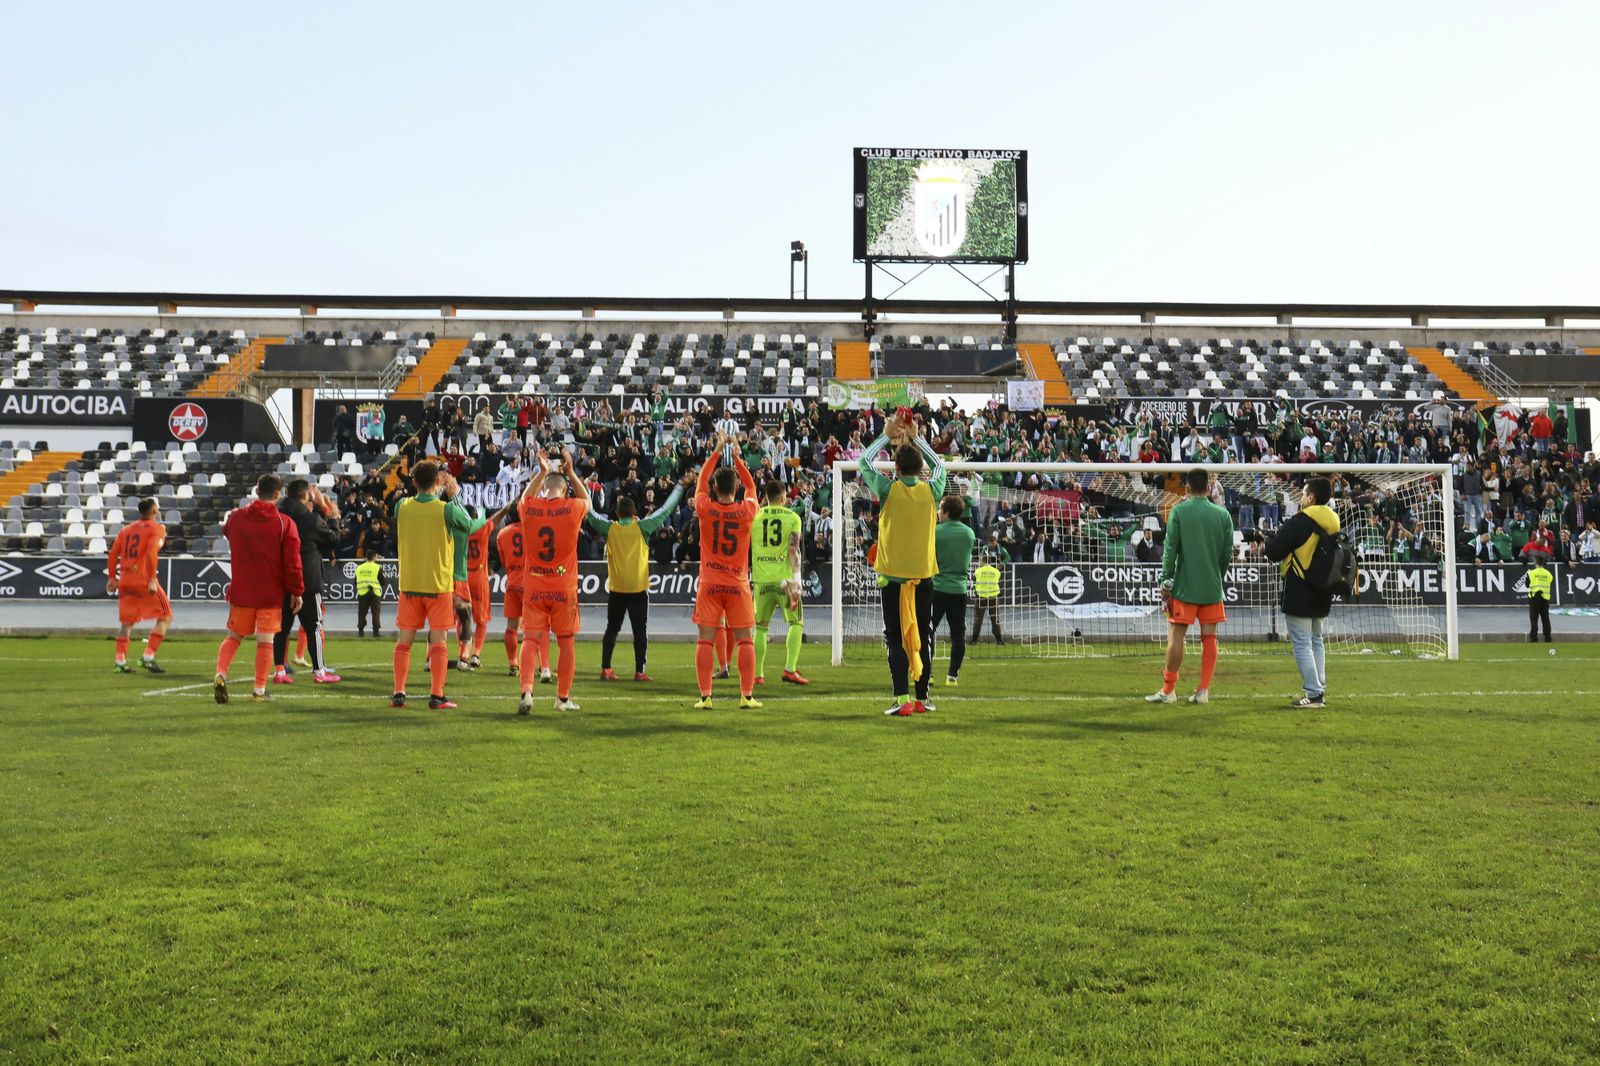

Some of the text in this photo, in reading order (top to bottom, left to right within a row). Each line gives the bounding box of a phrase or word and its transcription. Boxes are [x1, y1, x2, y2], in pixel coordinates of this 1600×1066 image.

[860, 148, 1021, 160] CLUB DEPORTIVO BADAJOZ
[2, 395, 127, 416] AUTOCIBA
[172, 418, 204, 427] DERBY
[538, 527, 555, 562] 3
[713, 521, 739, 557] 15
[763, 518, 782, 547] 13
[124, 534, 140, 559] 12
[512, 533, 523, 558] 9
[39, 584, 84, 596] umbro
[1397, 569, 1506, 593] MELIN
